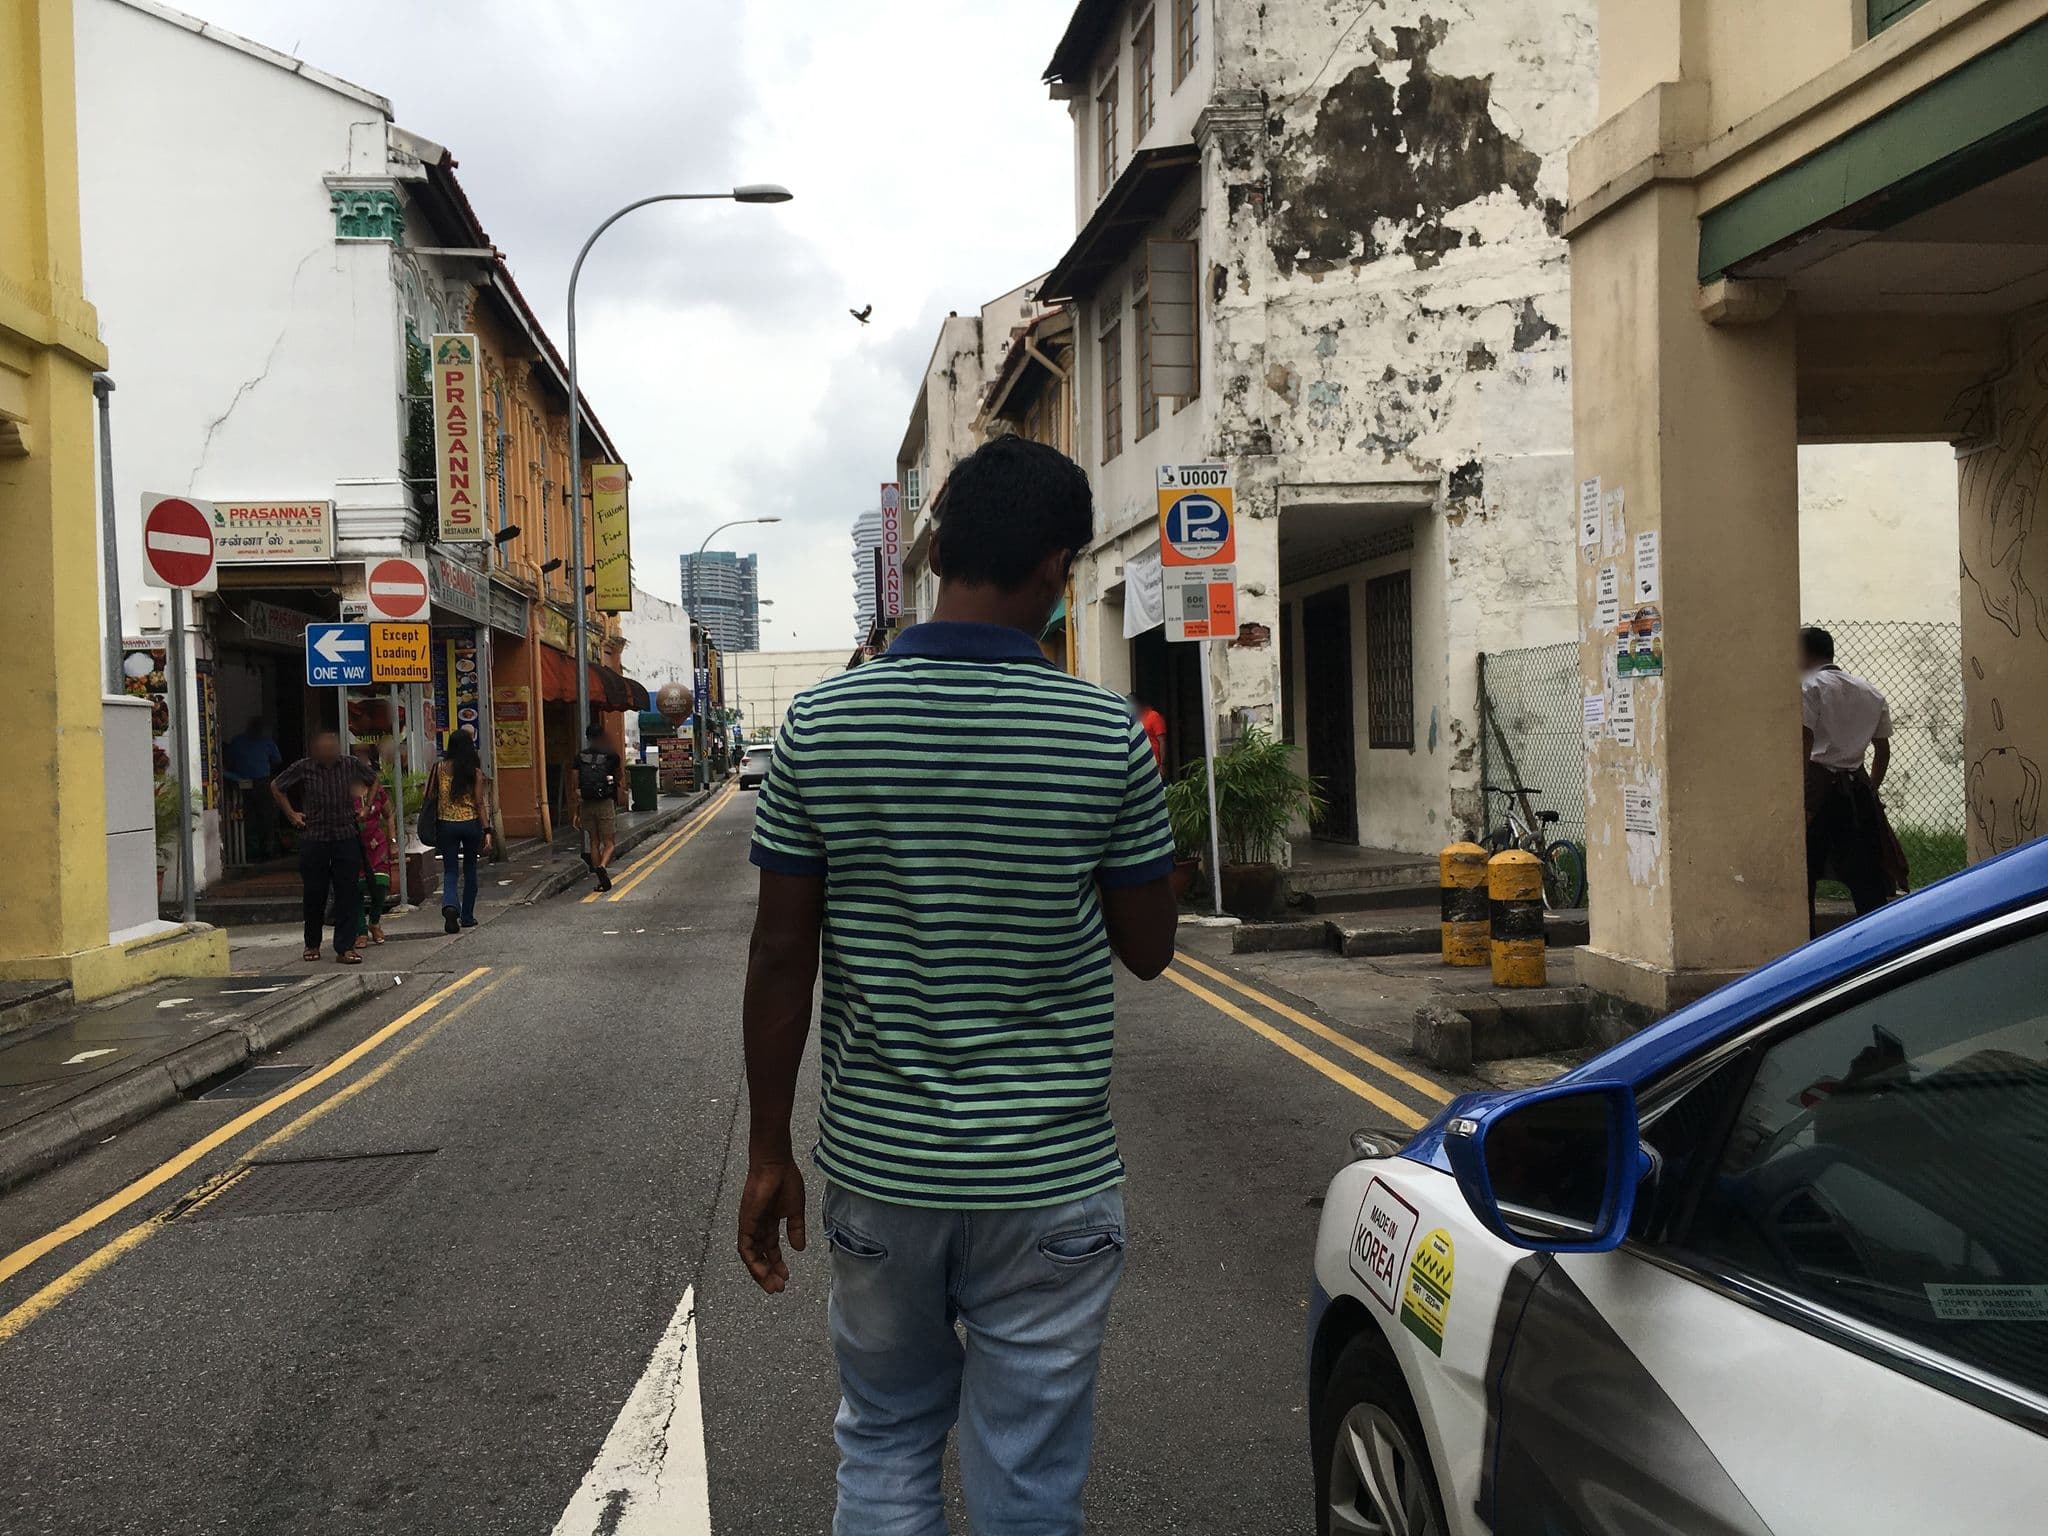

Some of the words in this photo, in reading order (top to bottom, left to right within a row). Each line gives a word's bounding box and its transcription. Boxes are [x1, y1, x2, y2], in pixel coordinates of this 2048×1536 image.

[445, 371, 477, 525] PRASANNA'S
[1180, 470, 1228, 486] U0007
[229, 505, 322, 519] PRASANNA'S
[230, 519, 322, 527] RESTAURANT
[1180, 500, 1221, 542] P
[444, 527, 480, 535] RESTAURANT
[601, 530, 623, 546] Fine
[596, 549, 629, 570] Dining
[884, 507, 900, 615] WOODLANDS
[382, 628, 419, 643] Except
[376, 646, 417, 661] Loading
[421, 645, 426, 659] /
[313, 667, 338, 679] ONE
[343, 666, 366, 679] WAY
[376, 664, 428, 678] Unloading
[1370, 1205, 1390, 1233] MADE
[1387, 1220, 1398, 1240] IN
[1355, 1223, 1395, 1288] KOREA
[1984, 1288, 2032, 1297] CAPACITY
